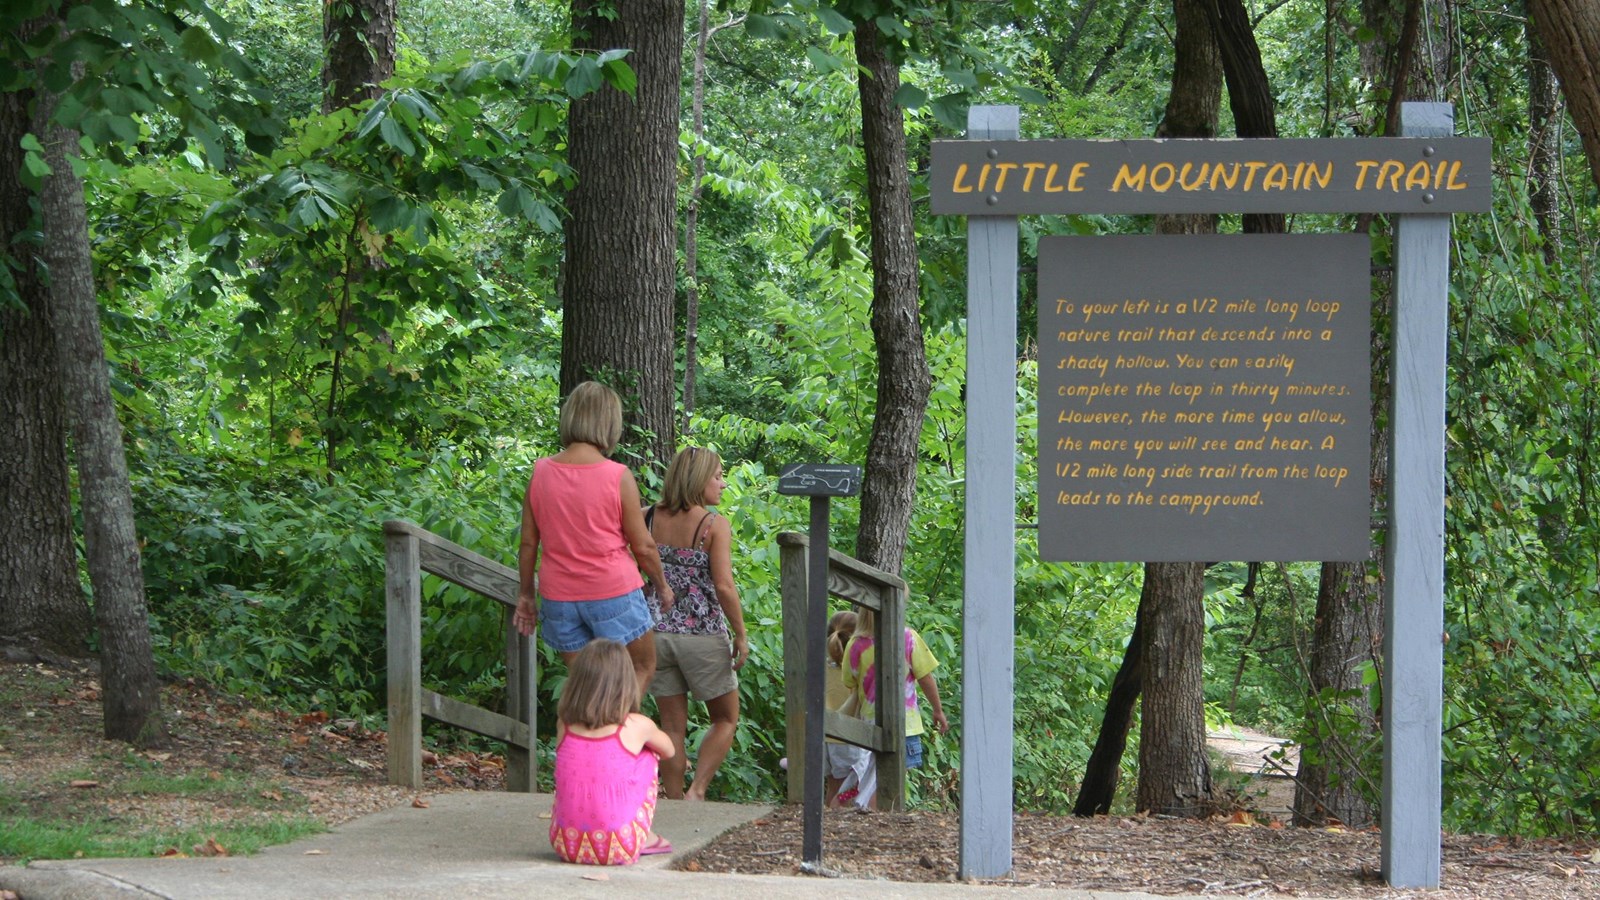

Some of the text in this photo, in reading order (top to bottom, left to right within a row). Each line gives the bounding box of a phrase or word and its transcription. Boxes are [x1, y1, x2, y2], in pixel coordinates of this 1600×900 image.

[952, 160, 1468, 193] LITTLE MOUNTAIN TRAIL
[1056, 298, 1341, 321] To your left is a 1/2 mile long loop
[1058, 326, 1333, 342] nature trail that descends into a
[1057, 354, 1296, 377] shady hollow. You can easily
[1058, 382, 1351, 404] complete the loop in thirty minutes.
[1058, 409, 1346, 431] However, the more time you allow,
[1057, 435, 1335, 459] the more you will see and hear. A
[1056, 463, 1349, 487] 1/2 mile long side trail from the loop
[1057, 491, 1264, 514] leads to the campground.
